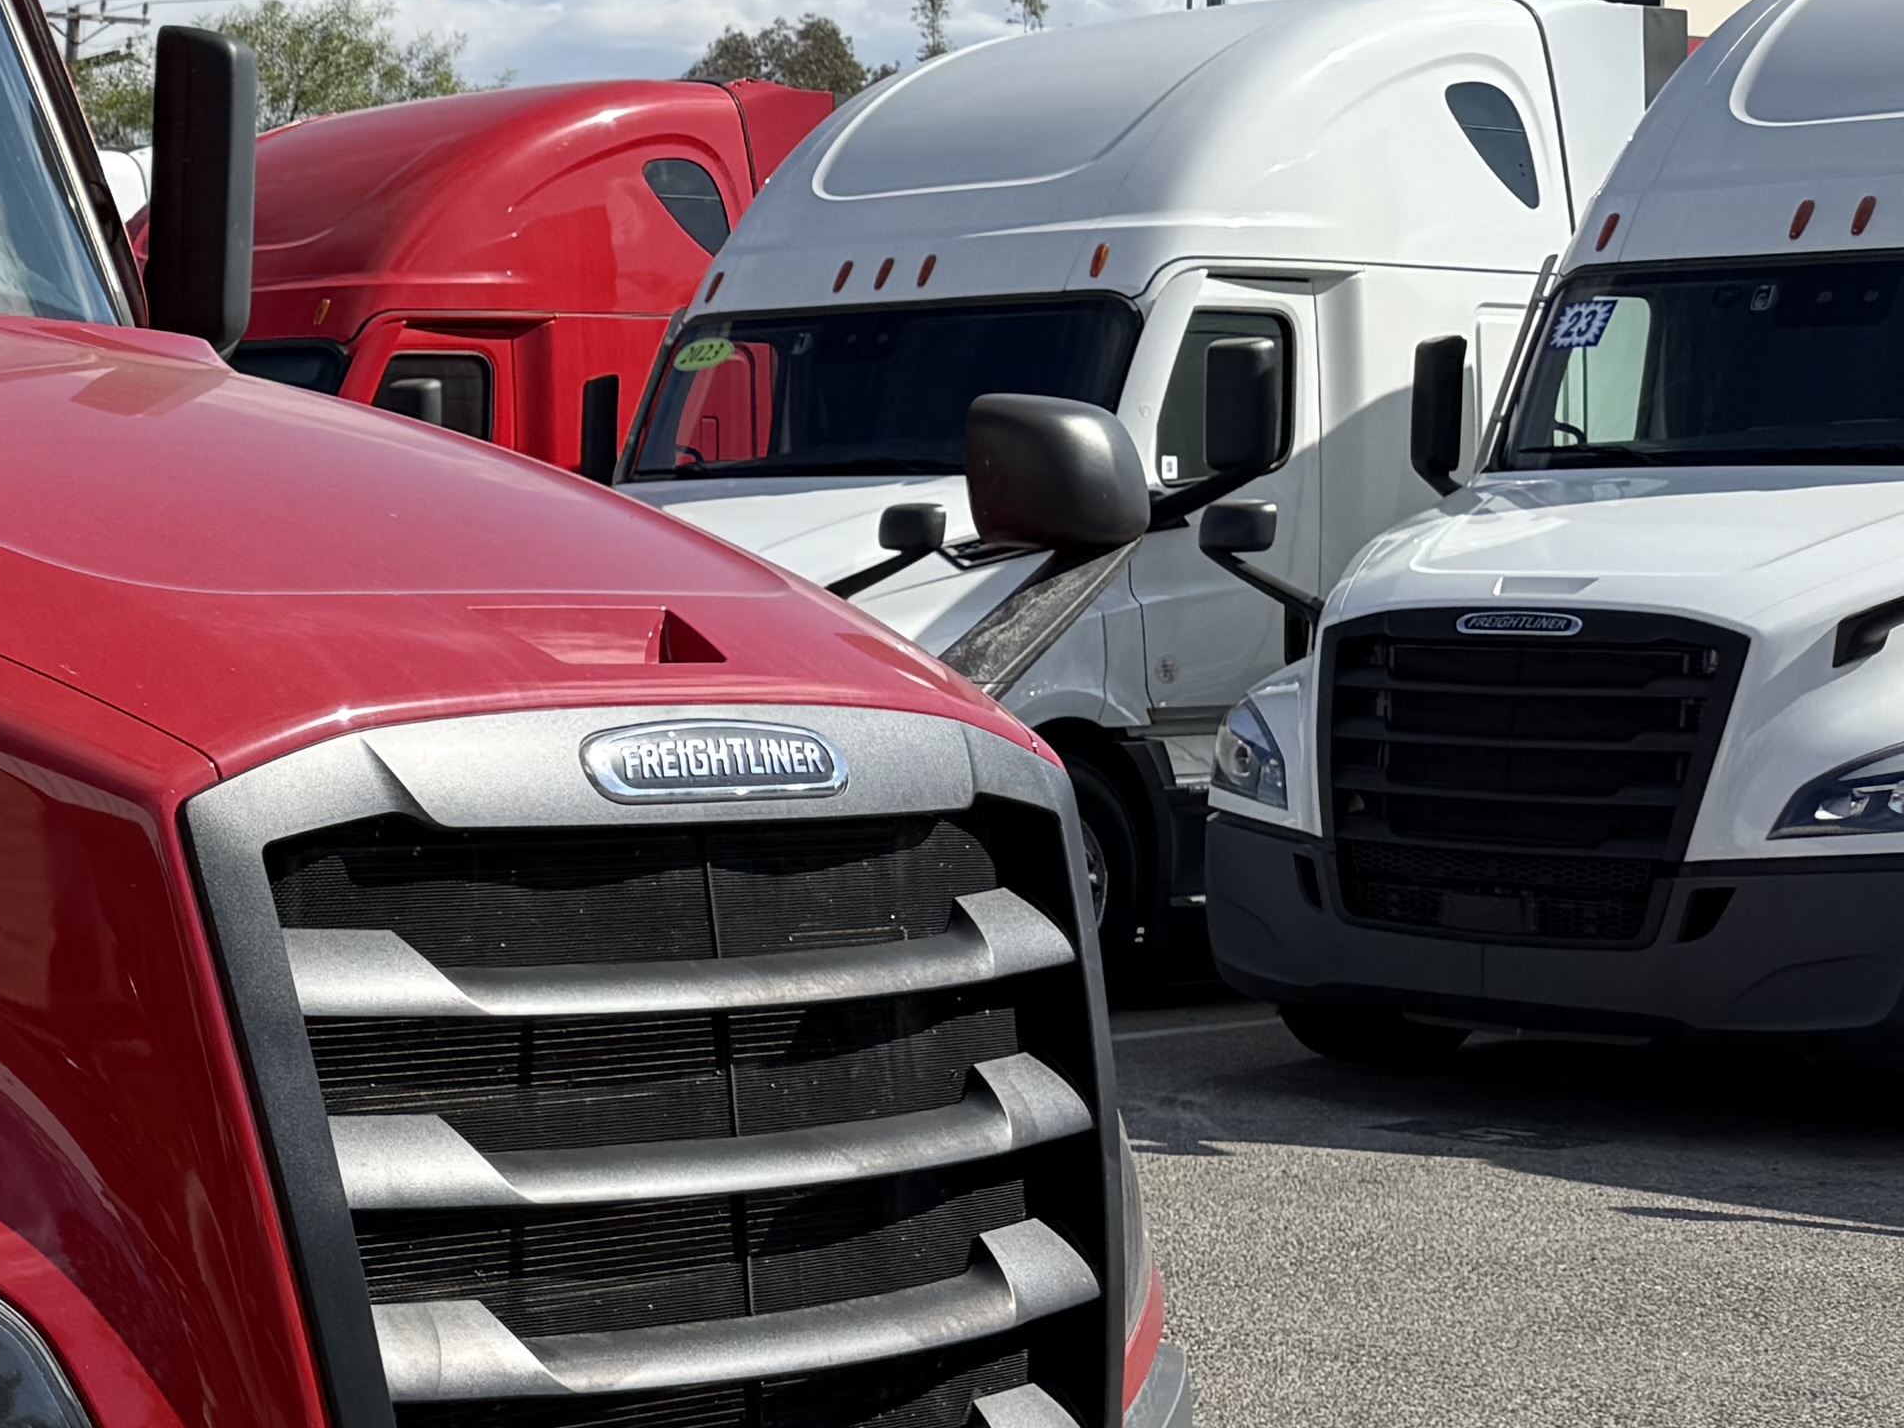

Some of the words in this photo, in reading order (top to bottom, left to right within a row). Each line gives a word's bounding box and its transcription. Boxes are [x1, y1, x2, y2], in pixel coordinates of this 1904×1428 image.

[1560, 309, 1598, 339] 23
[1467, 616, 1568, 630] FREIGHTLINER
[620, 736, 826, 781] FREIGHTLINER
